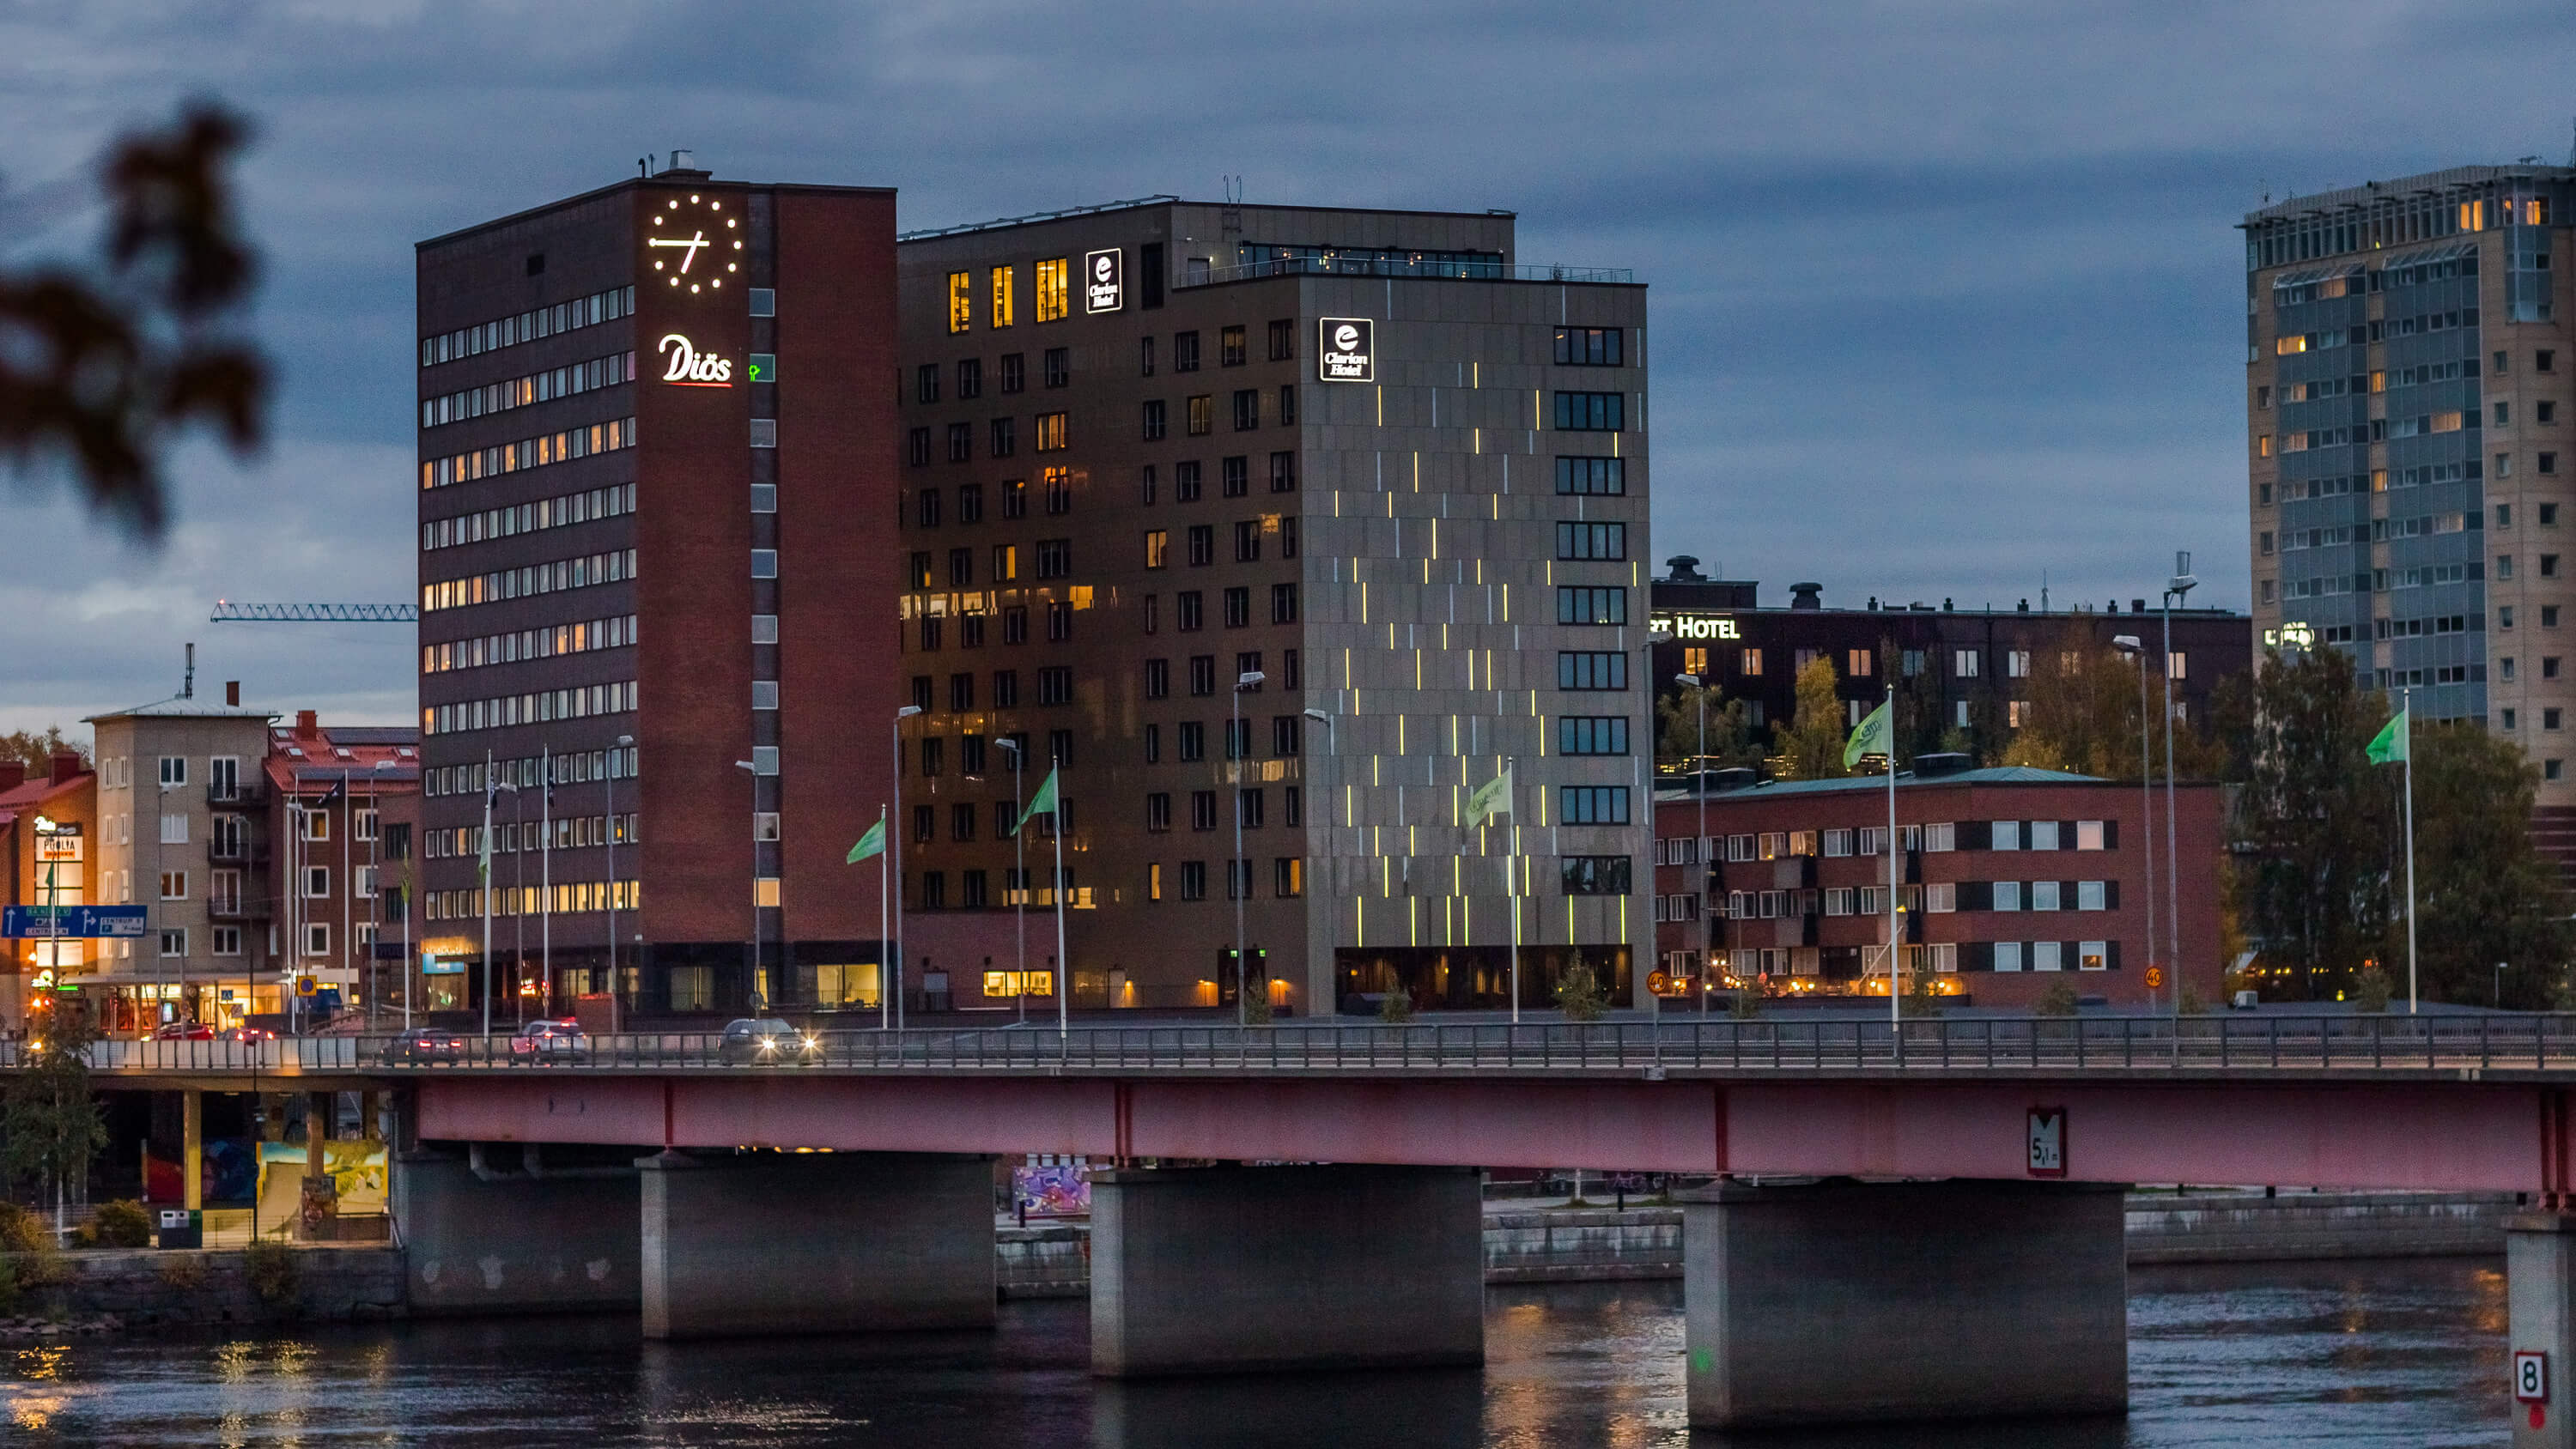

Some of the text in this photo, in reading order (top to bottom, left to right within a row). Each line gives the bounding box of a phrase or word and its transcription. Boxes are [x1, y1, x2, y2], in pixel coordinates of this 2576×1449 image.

[659, 334, 732, 381] Diös
[1325, 352, 1368, 365] Clarion
[1330, 364, 1362, 376] Hotel
[1650, 975, 1664, 988] 40
[2148, 972, 2161, 983] 40
[2523, 1361, 2538, 1392] 8
